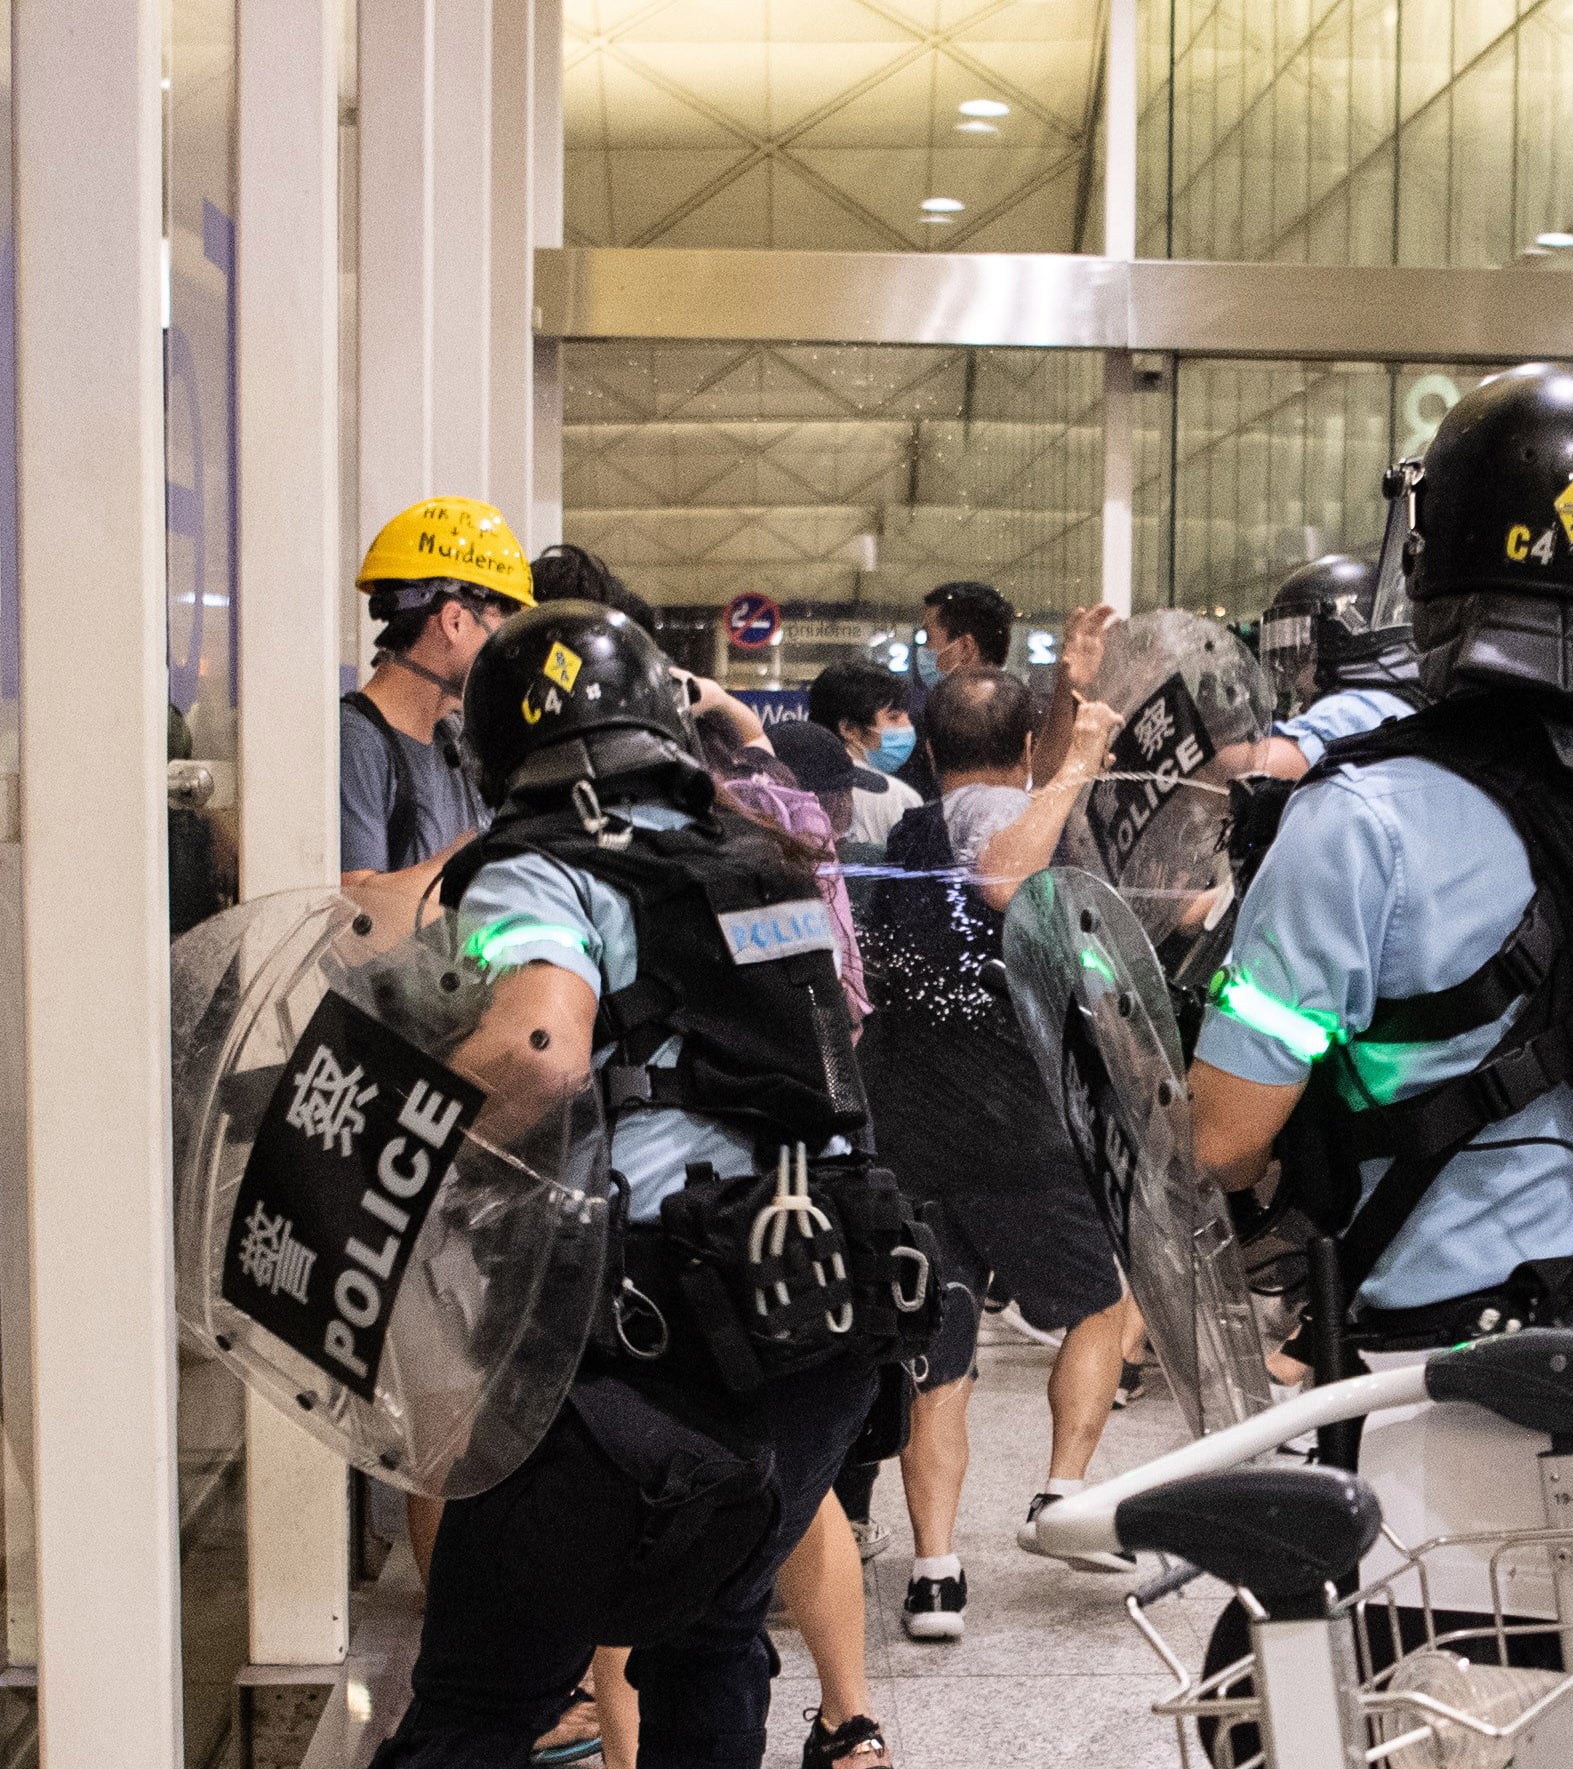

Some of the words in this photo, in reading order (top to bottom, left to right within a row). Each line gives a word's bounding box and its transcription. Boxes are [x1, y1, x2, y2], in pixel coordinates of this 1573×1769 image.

[418, 531, 517, 575] Murderer
[1506, 523, 1556, 566] C4
[239, 1044, 379, 1306] 警察
[323, 1077, 464, 1379] POLICE
